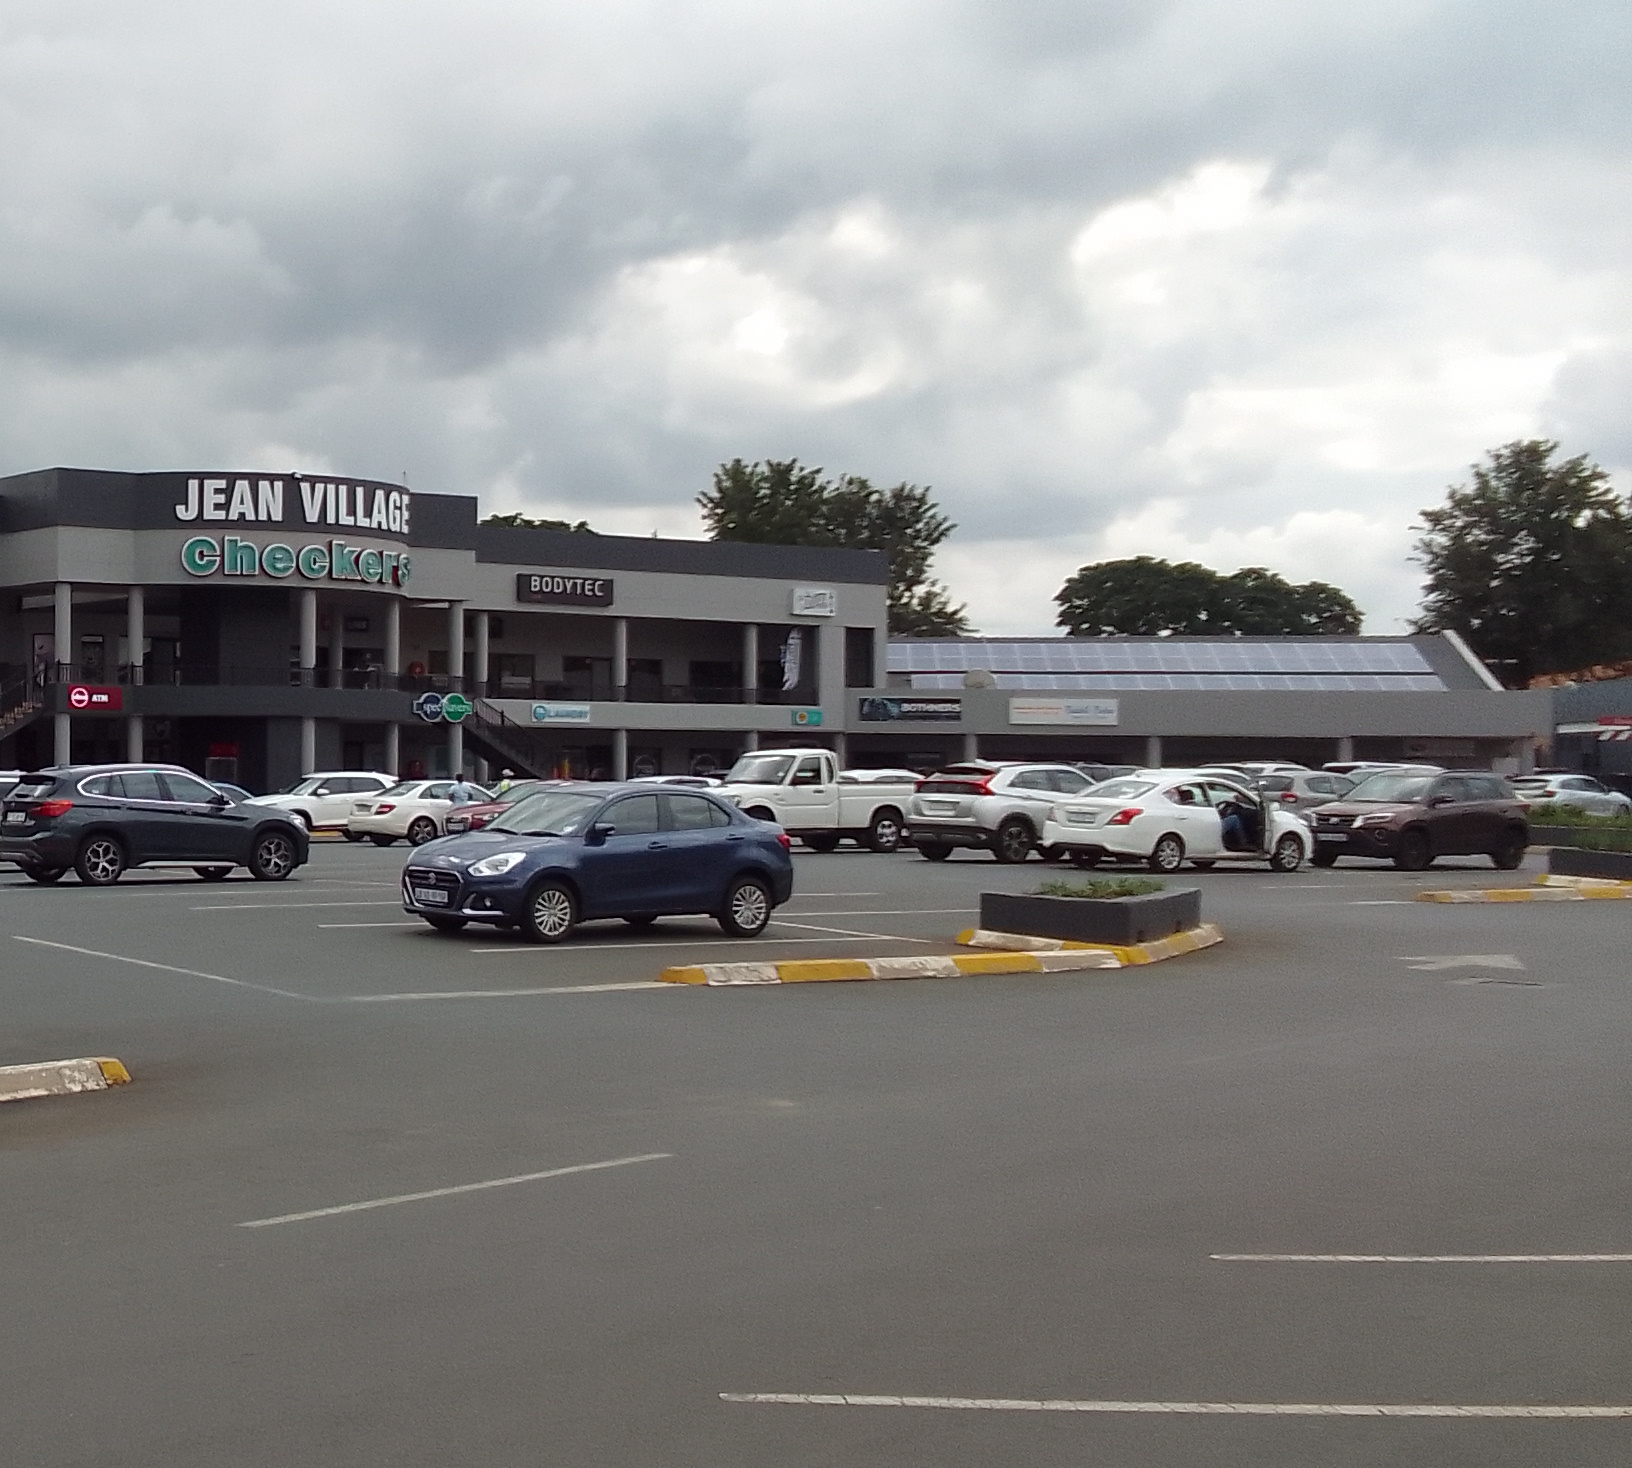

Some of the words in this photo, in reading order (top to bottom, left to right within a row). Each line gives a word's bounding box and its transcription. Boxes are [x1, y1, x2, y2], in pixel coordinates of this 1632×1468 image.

[175, 479, 284, 522] JEAN
[299, 482, 410, 534] VILLAGE
[181, 535, 411, 586] Checkers
[530, 576, 605, 597] BODYTEC
